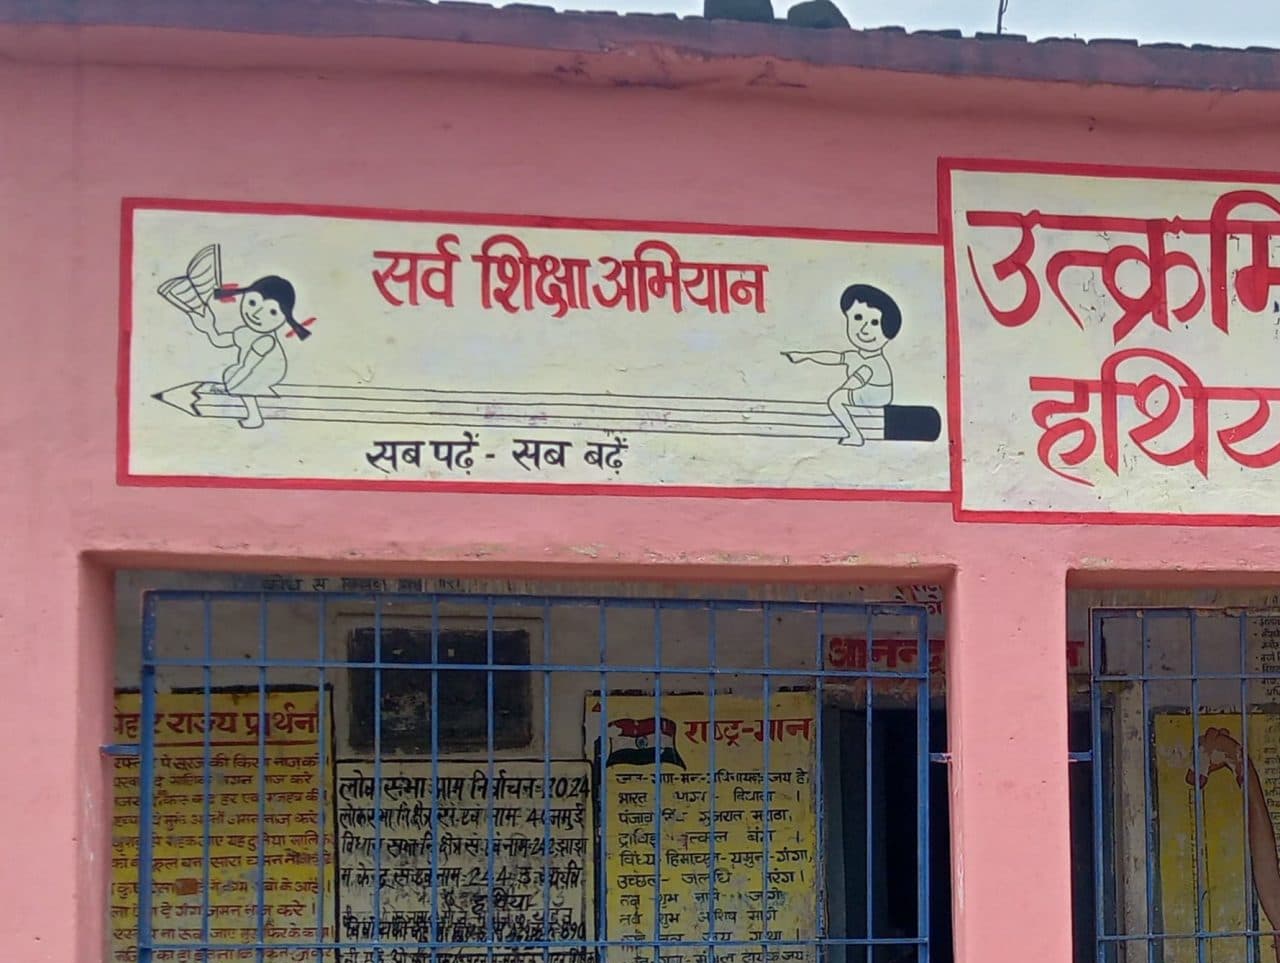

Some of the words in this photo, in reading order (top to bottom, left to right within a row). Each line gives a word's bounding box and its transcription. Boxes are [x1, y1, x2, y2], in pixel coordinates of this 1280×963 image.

[372, 234, 460, 308] सर्व
[471, 234, 590, 318] शिक्षा
[592, 239, 769, 314] अभियान
[366, 441, 426, 474] सब
[429, 431, 479, 475] पढ़ें
[512, 439, 572, 470] सब
[584, 437, 629, 475] बढ़ें
[166, 711, 240, 735] राज्य
